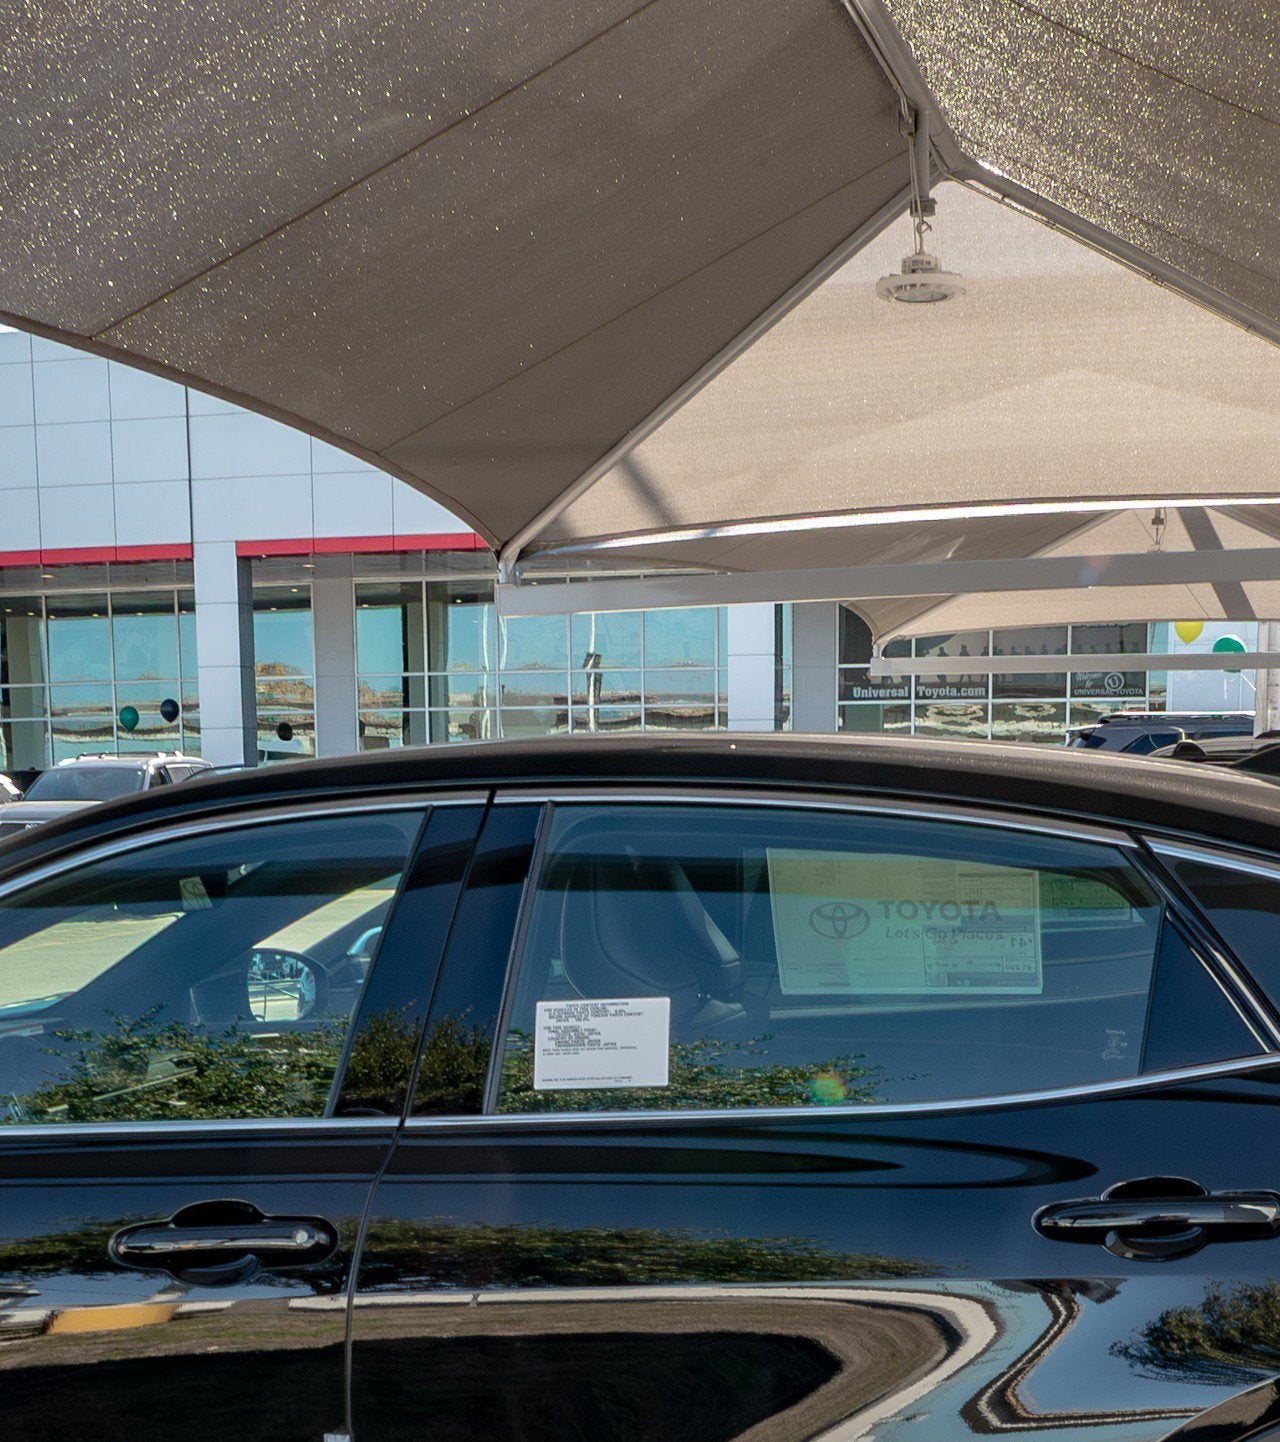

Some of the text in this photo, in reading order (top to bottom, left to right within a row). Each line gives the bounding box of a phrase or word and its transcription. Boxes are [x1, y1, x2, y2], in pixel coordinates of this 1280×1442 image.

[852, 686, 987, 699] Universal Toyota.com
[1074, 688, 1114, 696] UNIVERSAL
[876, 899, 1003, 922] TOYOTA
[885, 925, 1004, 941] Let's Go Places
